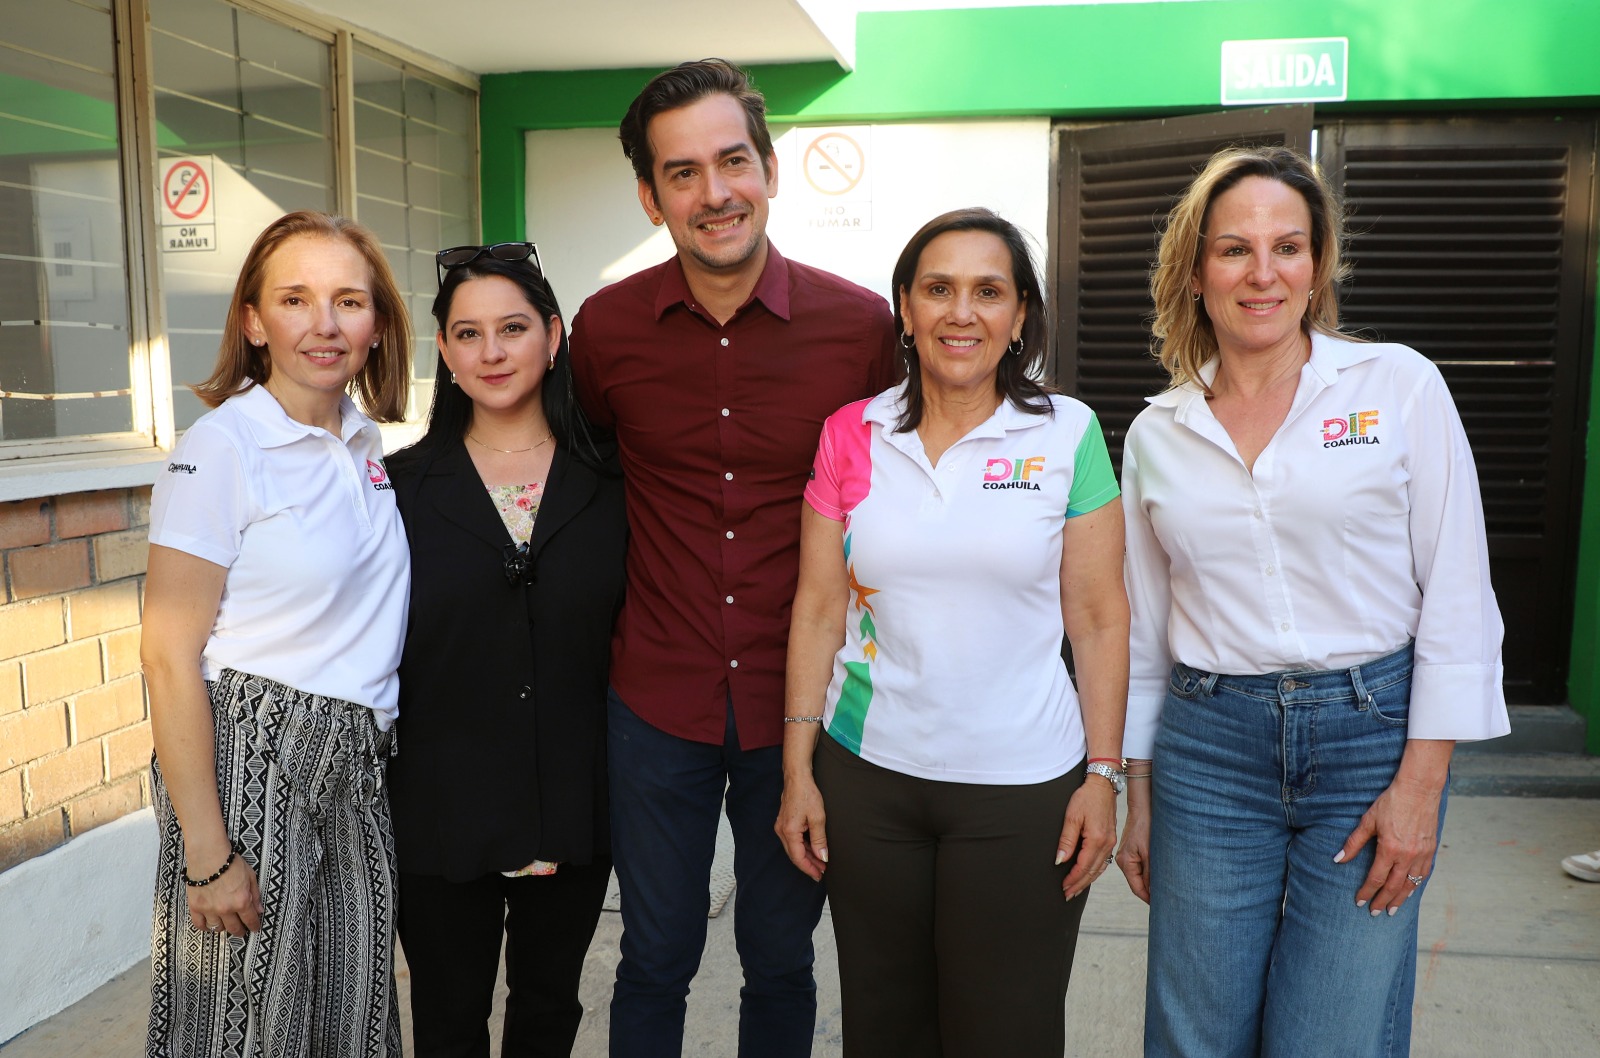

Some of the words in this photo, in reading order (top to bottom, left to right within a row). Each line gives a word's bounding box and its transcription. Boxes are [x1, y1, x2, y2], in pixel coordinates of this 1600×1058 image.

[1234, 52, 1336, 90] SALIDA
[824, 206, 845, 216] NO
[809, 217, 861, 228] FUMAR
[1323, 410, 1379, 441] DIF
[1323, 436, 1380, 448] COAHUILA
[984, 456, 1046, 481] DIF
[374, 482, 394, 490] COAH
[983, 481, 1041, 491] COAHUILA
